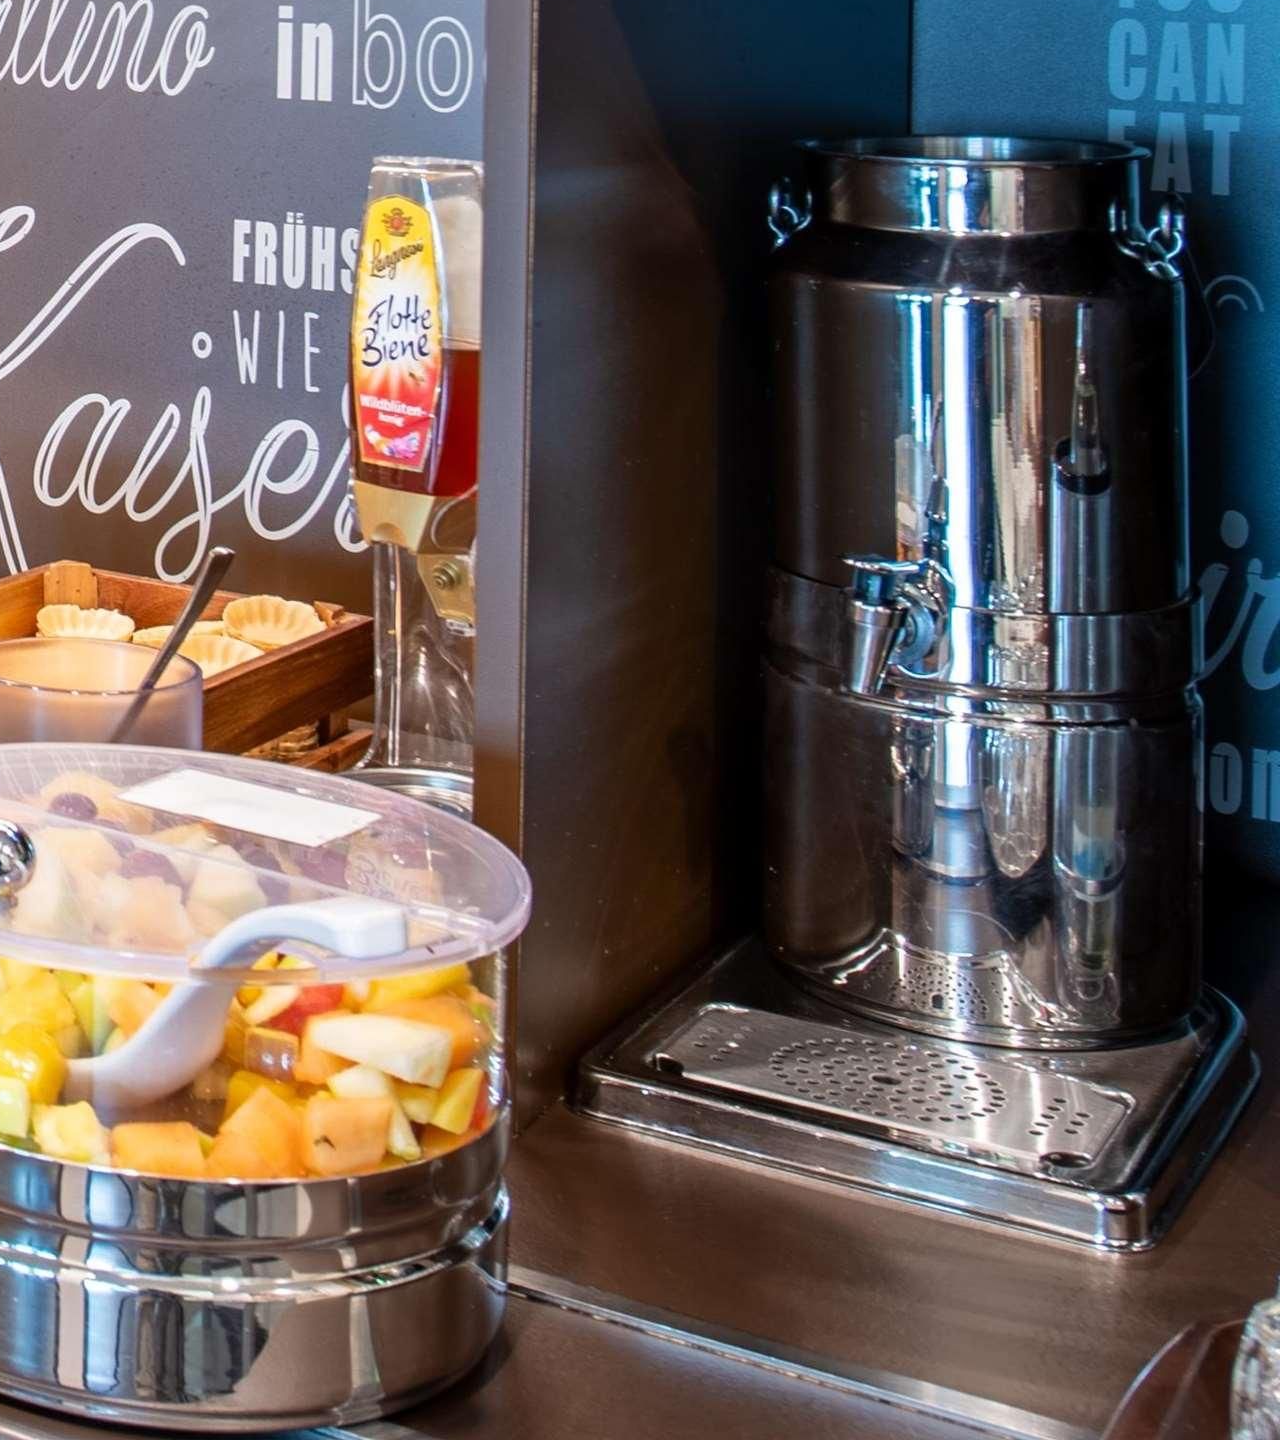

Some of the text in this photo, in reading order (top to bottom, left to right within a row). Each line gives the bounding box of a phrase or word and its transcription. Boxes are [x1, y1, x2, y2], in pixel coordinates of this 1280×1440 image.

[276, 4, 334, 104] in
[1106, 17, 1246, 106] CAN
[232, 308, 322, 394] WIE
[361, 326, 432, 367] Biene
[366, 293, 434, 334] Flotte
